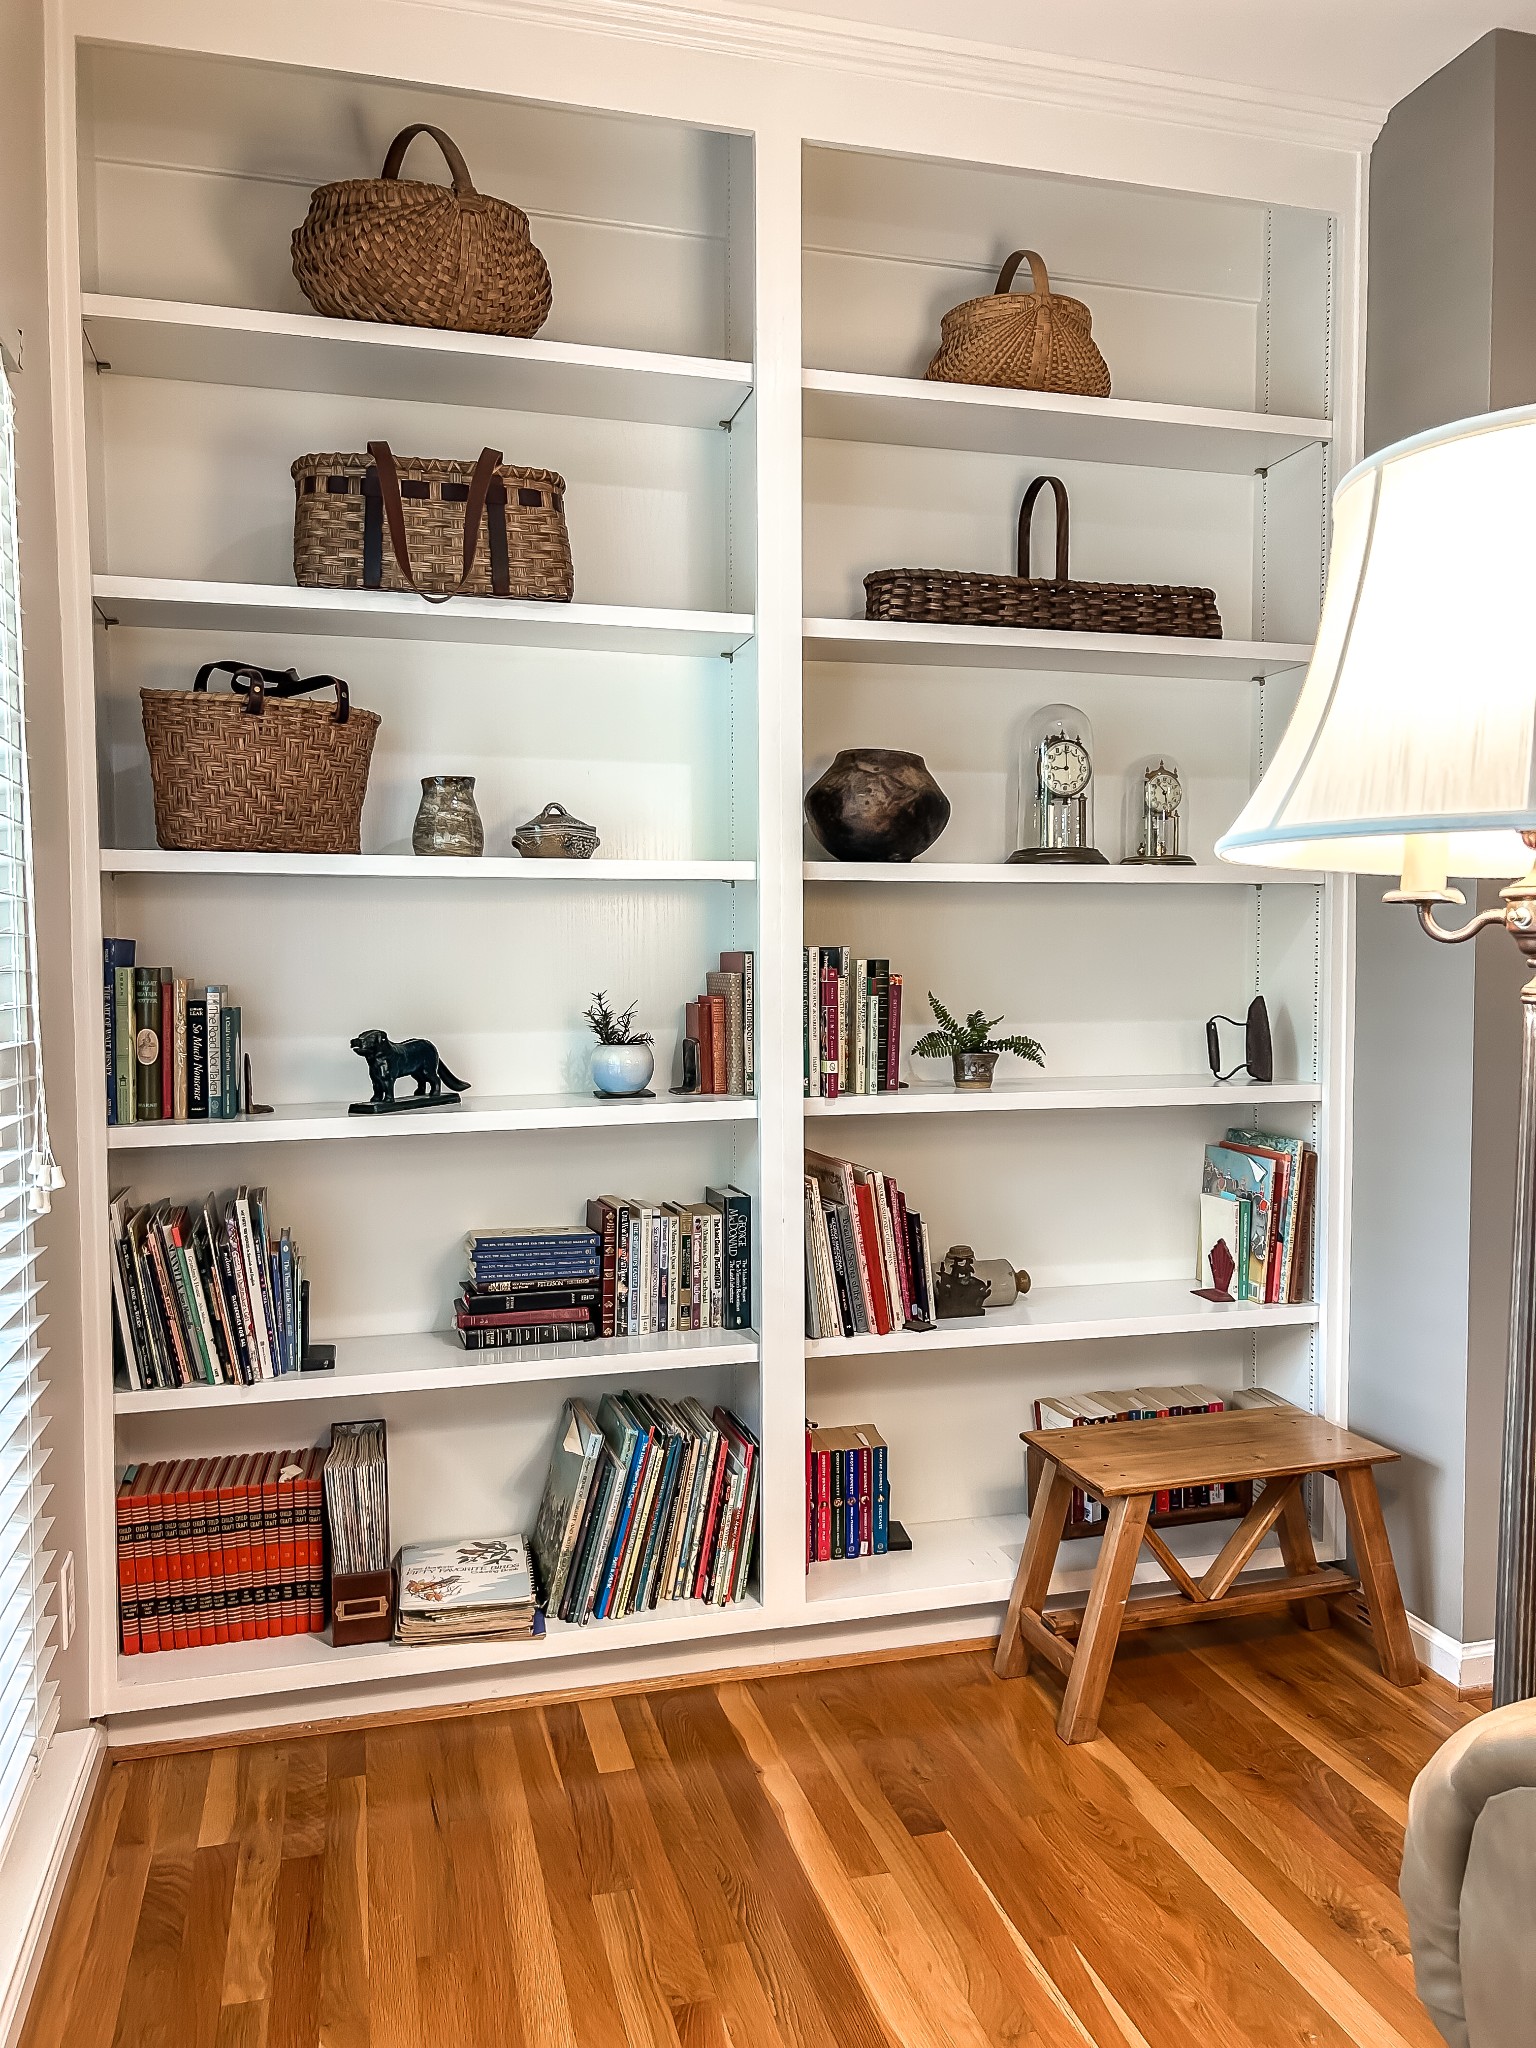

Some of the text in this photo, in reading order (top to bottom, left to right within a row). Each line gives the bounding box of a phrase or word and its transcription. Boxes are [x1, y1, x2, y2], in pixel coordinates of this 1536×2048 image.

[192, 1023, 203, 1034] So
[192, 1036, 203, 1061] Much
[209, 1006, 219, 1096] The Road Not Taken
[193, 1063, 203, 1101] Nonsense
[283, 1272, 291, 1288] Three
[284, 1288, 293, 1303] Little
[285, 1303, 294, 1323] Kittens
